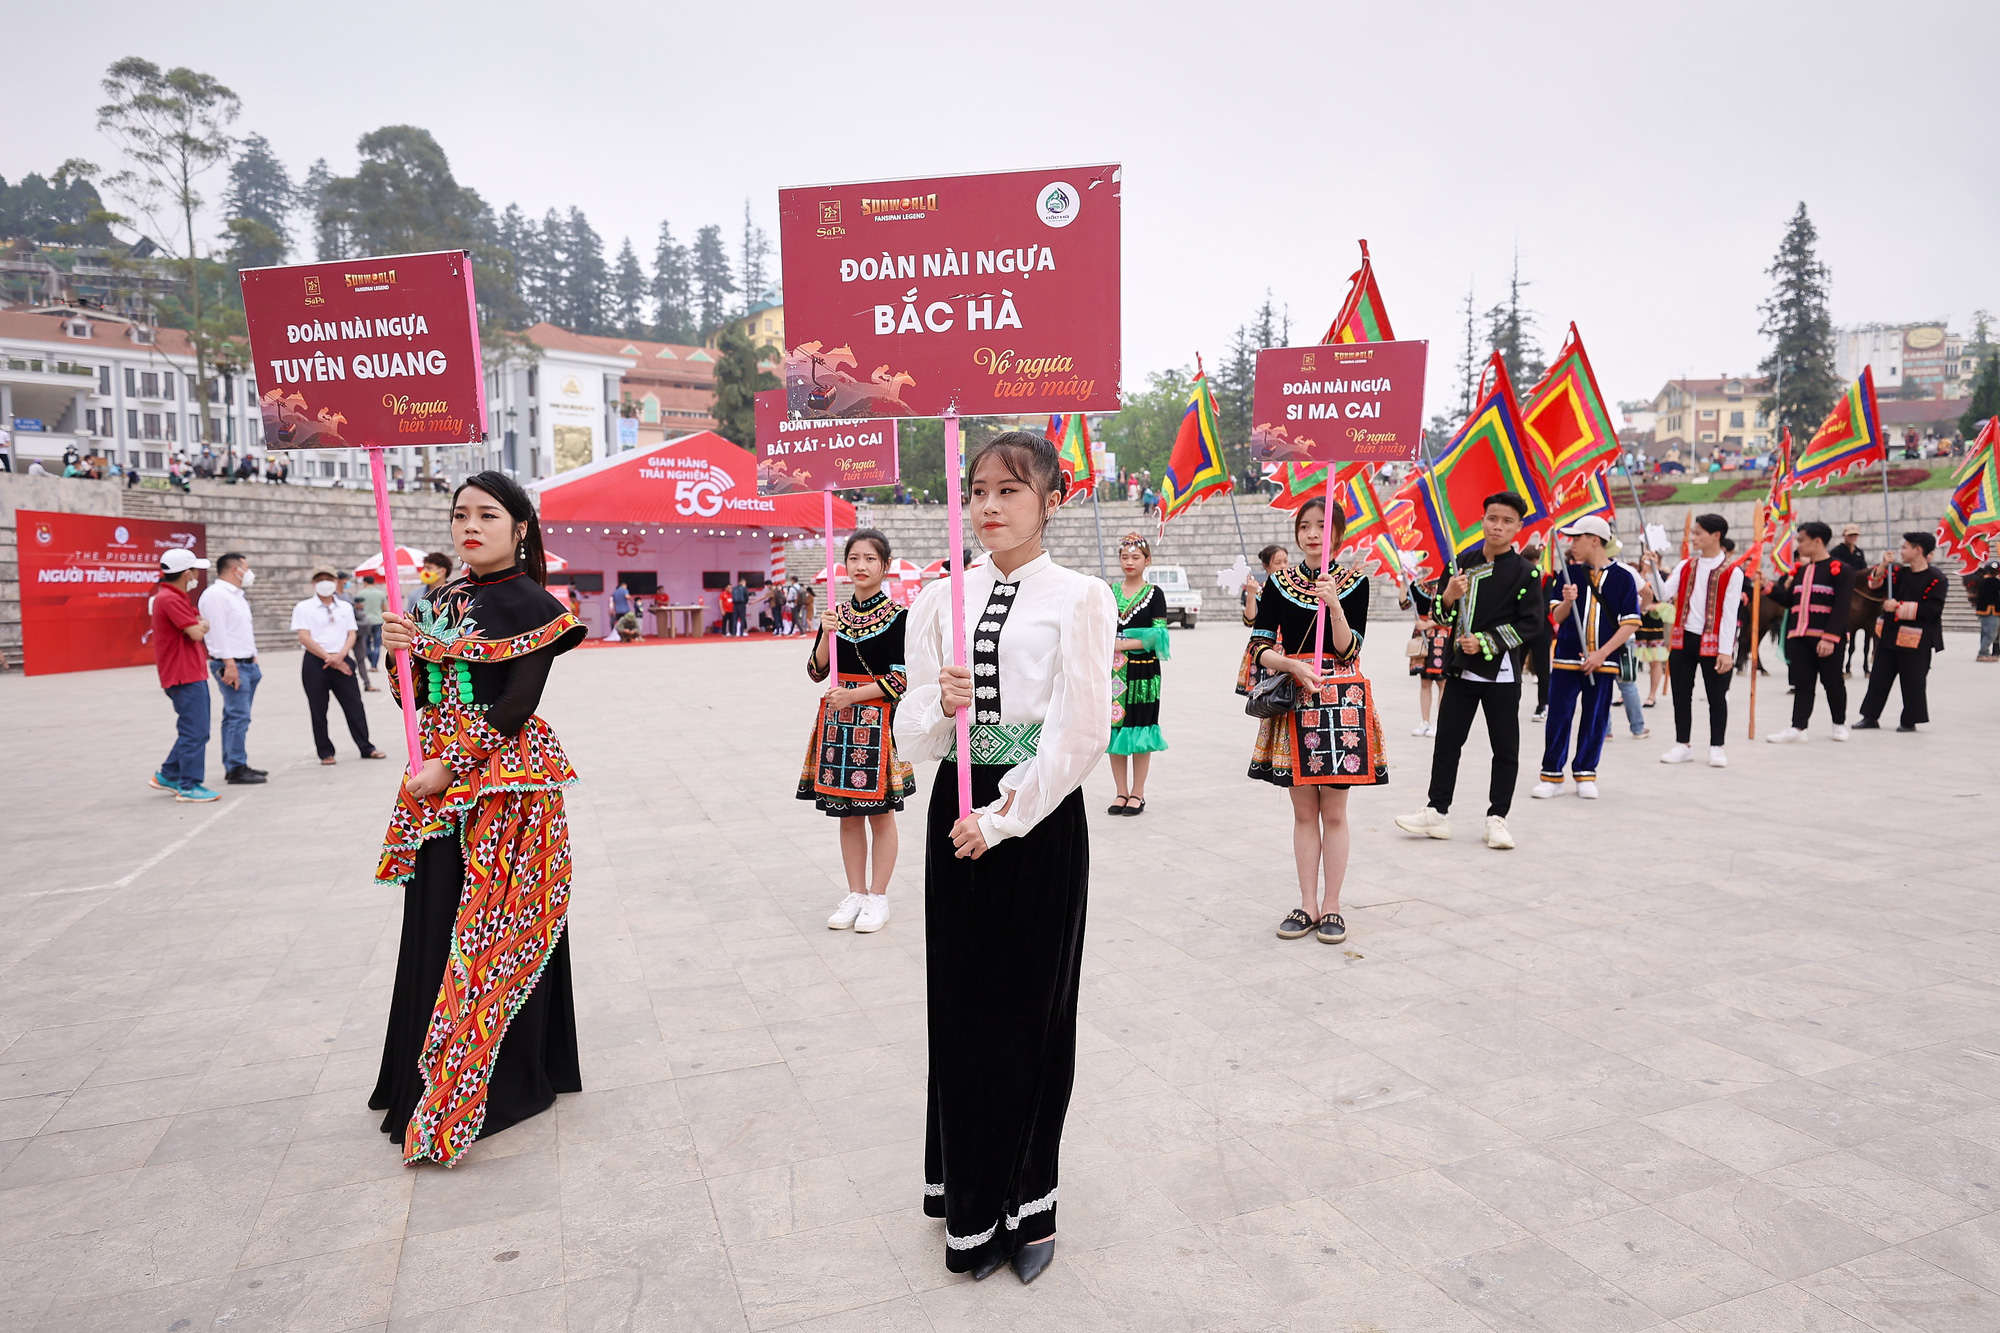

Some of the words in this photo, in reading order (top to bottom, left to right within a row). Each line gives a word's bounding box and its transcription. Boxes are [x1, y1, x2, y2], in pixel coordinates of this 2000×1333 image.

[861, 193, 938, 216] SUNWORLD
[874, 214, 902, 222] FANSIPAN
[902, 212, 926, 221] LEGEND
[816, 226, 847, 238] SaPa
[839, 251, 916, 283] ĐOÀN
[923, 247, 969, 277] NÀI
[976, 243, 1056, 280] NGỰA
[873, 286, 955, 336] BẮC
[967, 288, 1023, 332] HÀ
[287, 319, 338, 344] ĐOÀN
[341, 316, 372, 340] NÀI
[375, 313, 429, 341] NGỰA
[270, 350, 346, 384] TUYÊN
[352, 349, 447, 380] QUANG
[973, 347, 1015, 375] Vó
[1015, 354, 1074, 380] ngựa
[993, 377, 1037, 398] trên
[1040, 374, 1096, 402] mây
[1282, 379, 1321, 396] ĐOÀN
[1324, 378, 1348, 394] NÀI
[1351, 377, 1392, 396] NGỰA
[382, 393, 409, 416] Vó
[410, 399, 449, 418] ngựa
[1286, 404, 1303, 421] SI
[1308, 403, 1339, 420] MA
[1344, 401, 1382, 419] CAI
[398, 417, 426, 433] trên
[427, 415, 464, 436] mây
[766, 440, 791, 456] BÁT
[793, 437, 819, 454] XÁT
[828, 433, 855, 450] LÀO
[858, 431, 883, 447] CAI
[648, 456, 676, 468] GIAN
[677, 457, 708, 469] HÀNG
[639, 468, 664, 480] TRẢI
[667, 468, 710, 481] NGHIỆM
[674, 481, 724, 517] 5G
[723, 496, 776, 512] viettel
[75, 550, 100, 561] THE
[106, 551, 159, 563] PIONEER
[617, 541, 639, 557] 5G
[38, 565, 84, 583] NGƯỜI
[86, 567, 116, 583] TIÊN
[116, 569, 161, 584] PHONG
